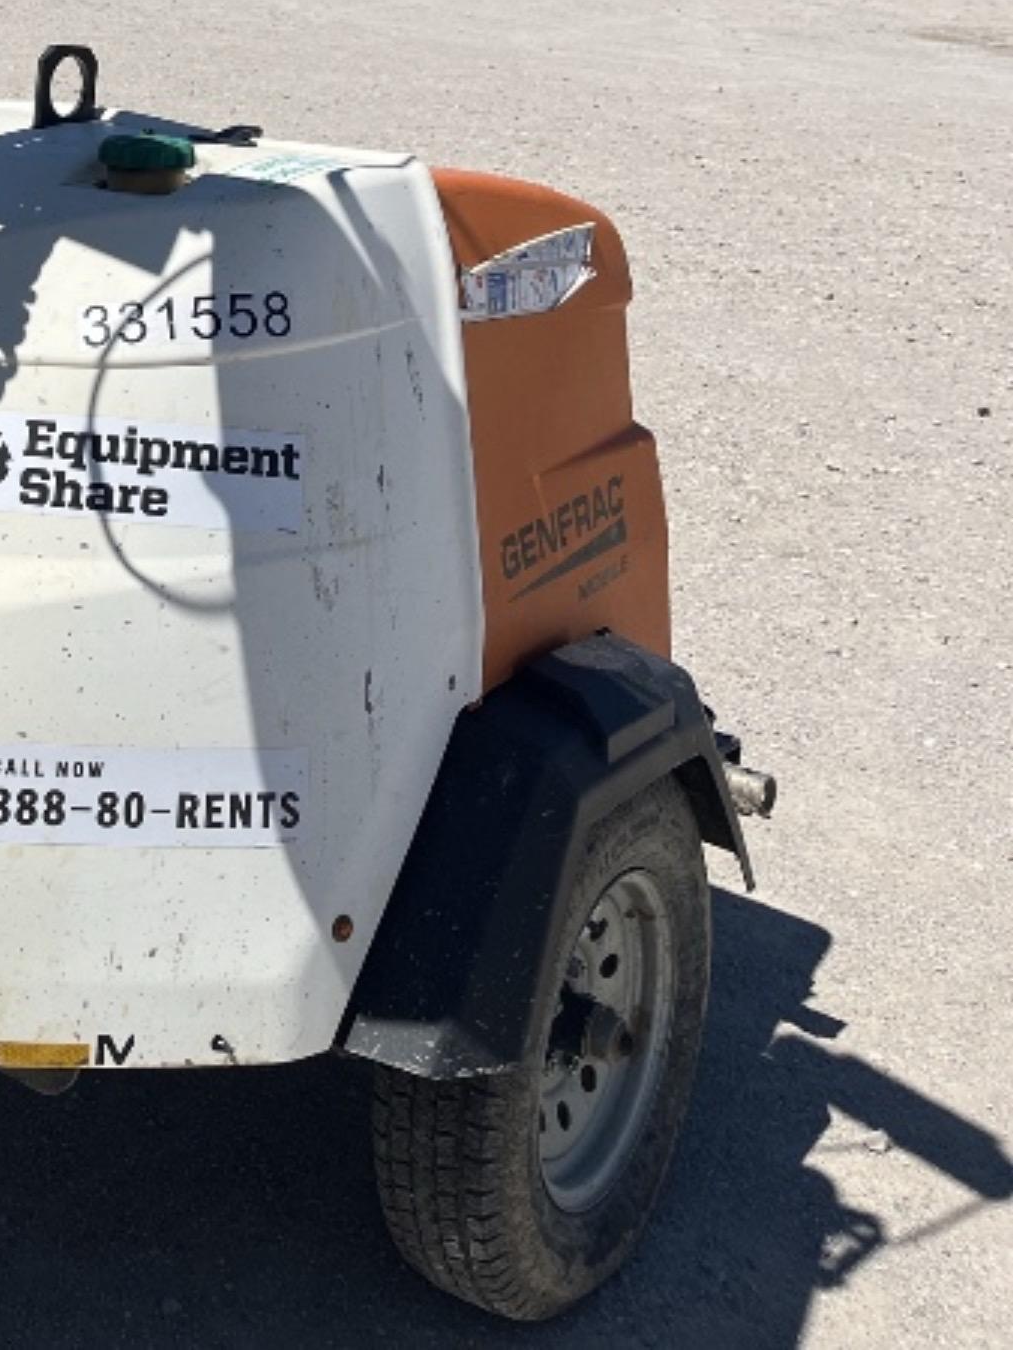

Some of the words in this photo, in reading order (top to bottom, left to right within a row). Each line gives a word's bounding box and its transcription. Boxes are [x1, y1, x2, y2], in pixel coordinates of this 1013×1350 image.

[82, 290, 292, 347] 331558
[23, 419, 301, 480] Equipment
[19, 467, 169, 517] Share
[55, 761, 105, 778] NOW
